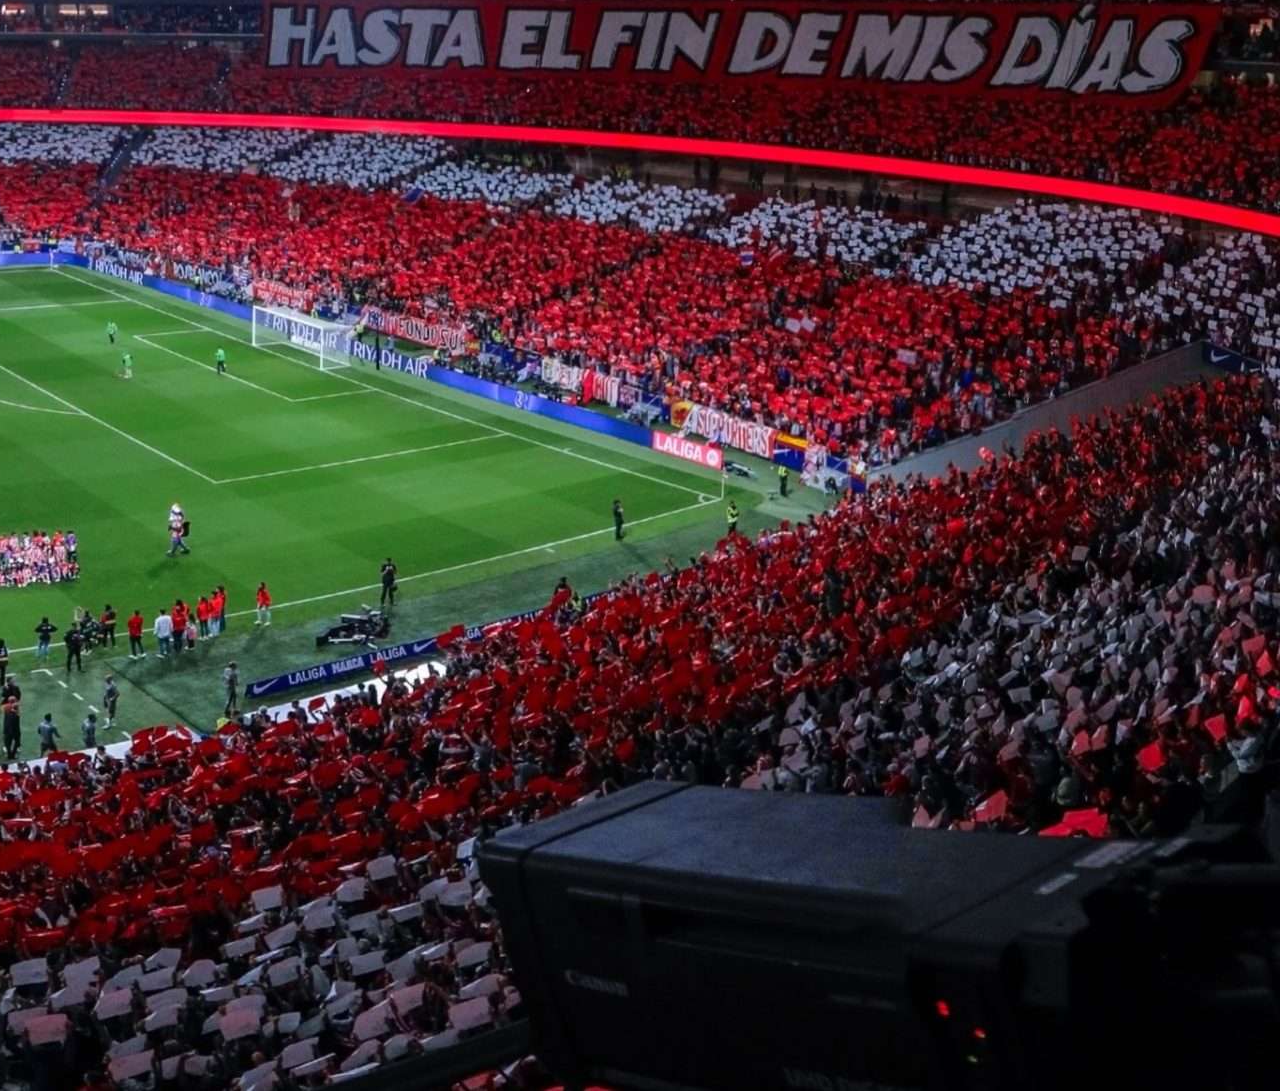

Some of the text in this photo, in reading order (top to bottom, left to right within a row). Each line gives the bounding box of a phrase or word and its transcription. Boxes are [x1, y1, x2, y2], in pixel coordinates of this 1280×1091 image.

[268, 4, 1194, 93] HASTA EL FIN DE MIS DÍAS
[95, 260, 143, 287] RIYADH AIR
[404, 357, 428, 379] AIR
[655, 432, 703, 462] LALIGA
[288, 645, 407, 685] LALIGA MARCA LALIGA
